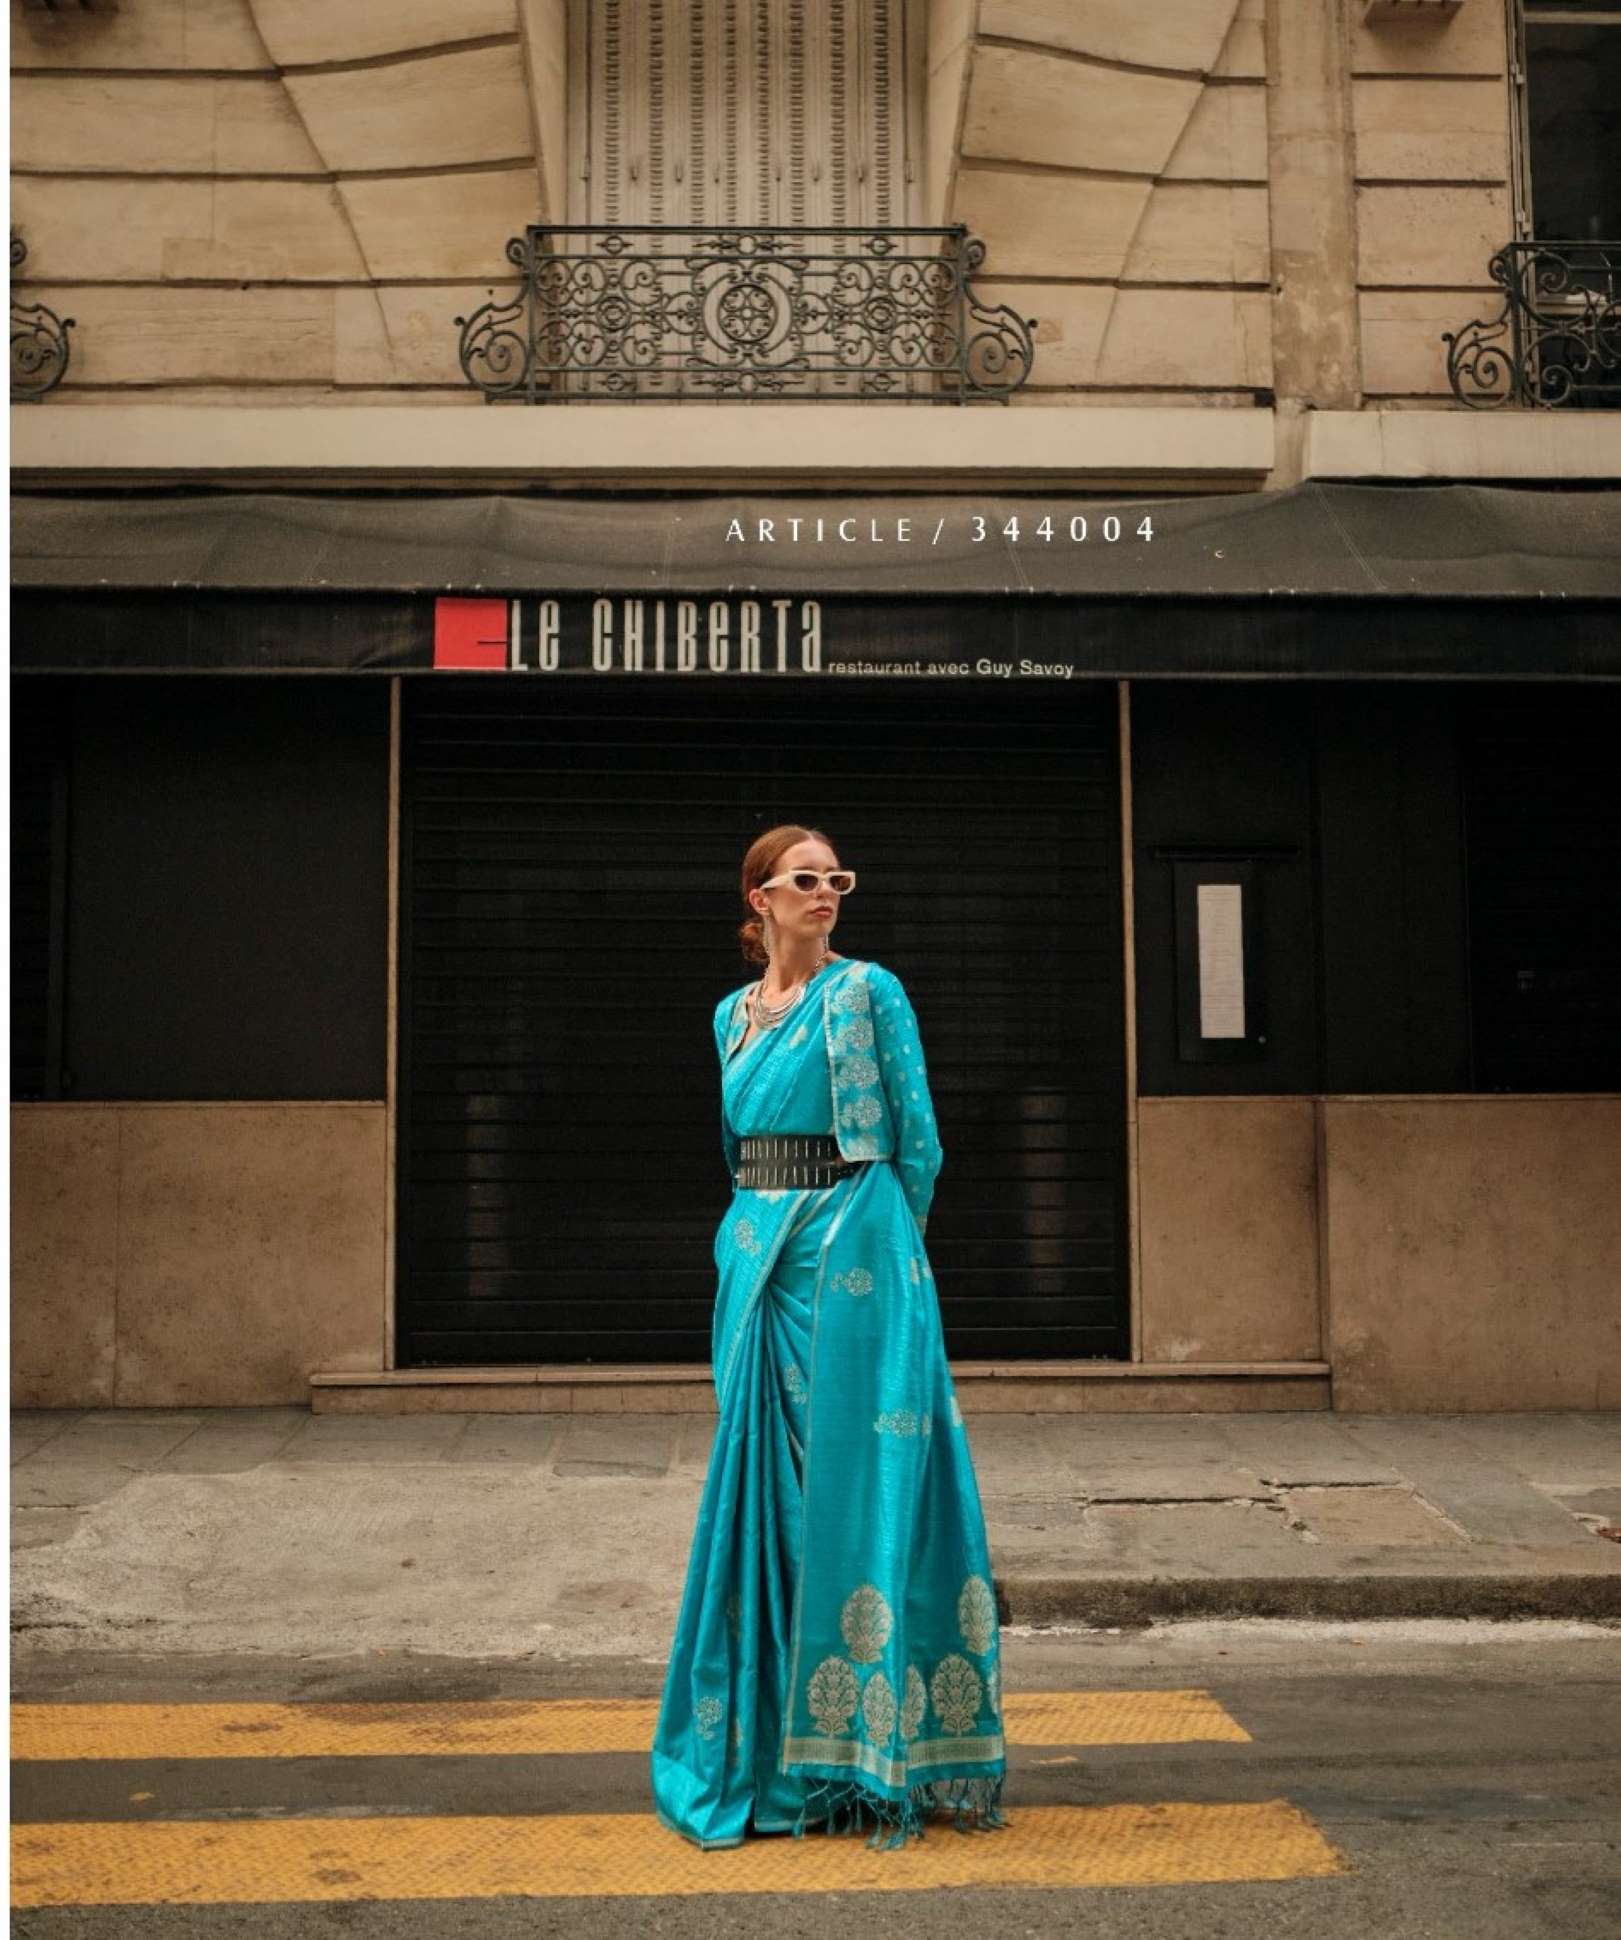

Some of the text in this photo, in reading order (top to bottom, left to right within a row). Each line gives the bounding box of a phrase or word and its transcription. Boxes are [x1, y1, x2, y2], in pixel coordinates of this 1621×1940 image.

[828, 658, 1074, 680] restaurant avec Guy Savoy
